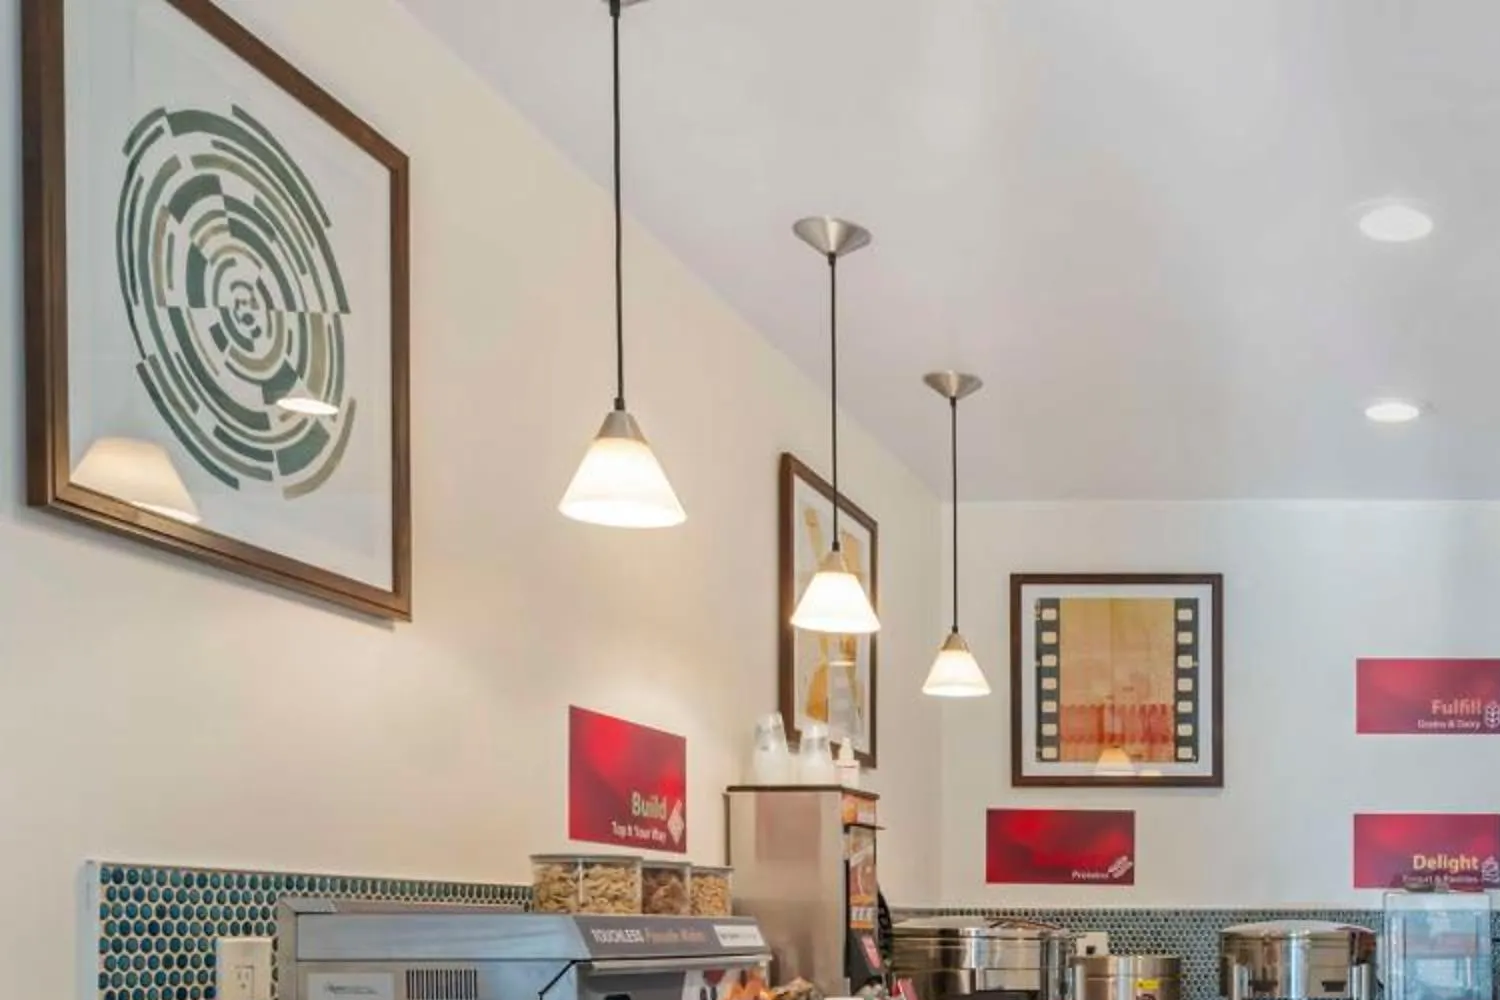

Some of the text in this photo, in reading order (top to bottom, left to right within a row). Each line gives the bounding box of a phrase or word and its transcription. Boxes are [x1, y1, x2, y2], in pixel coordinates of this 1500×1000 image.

[1431, 698, 1481, 715] Fulfill
[631, 791, 667, 820] Build
[1413, 854, 1479, 874] Delight
